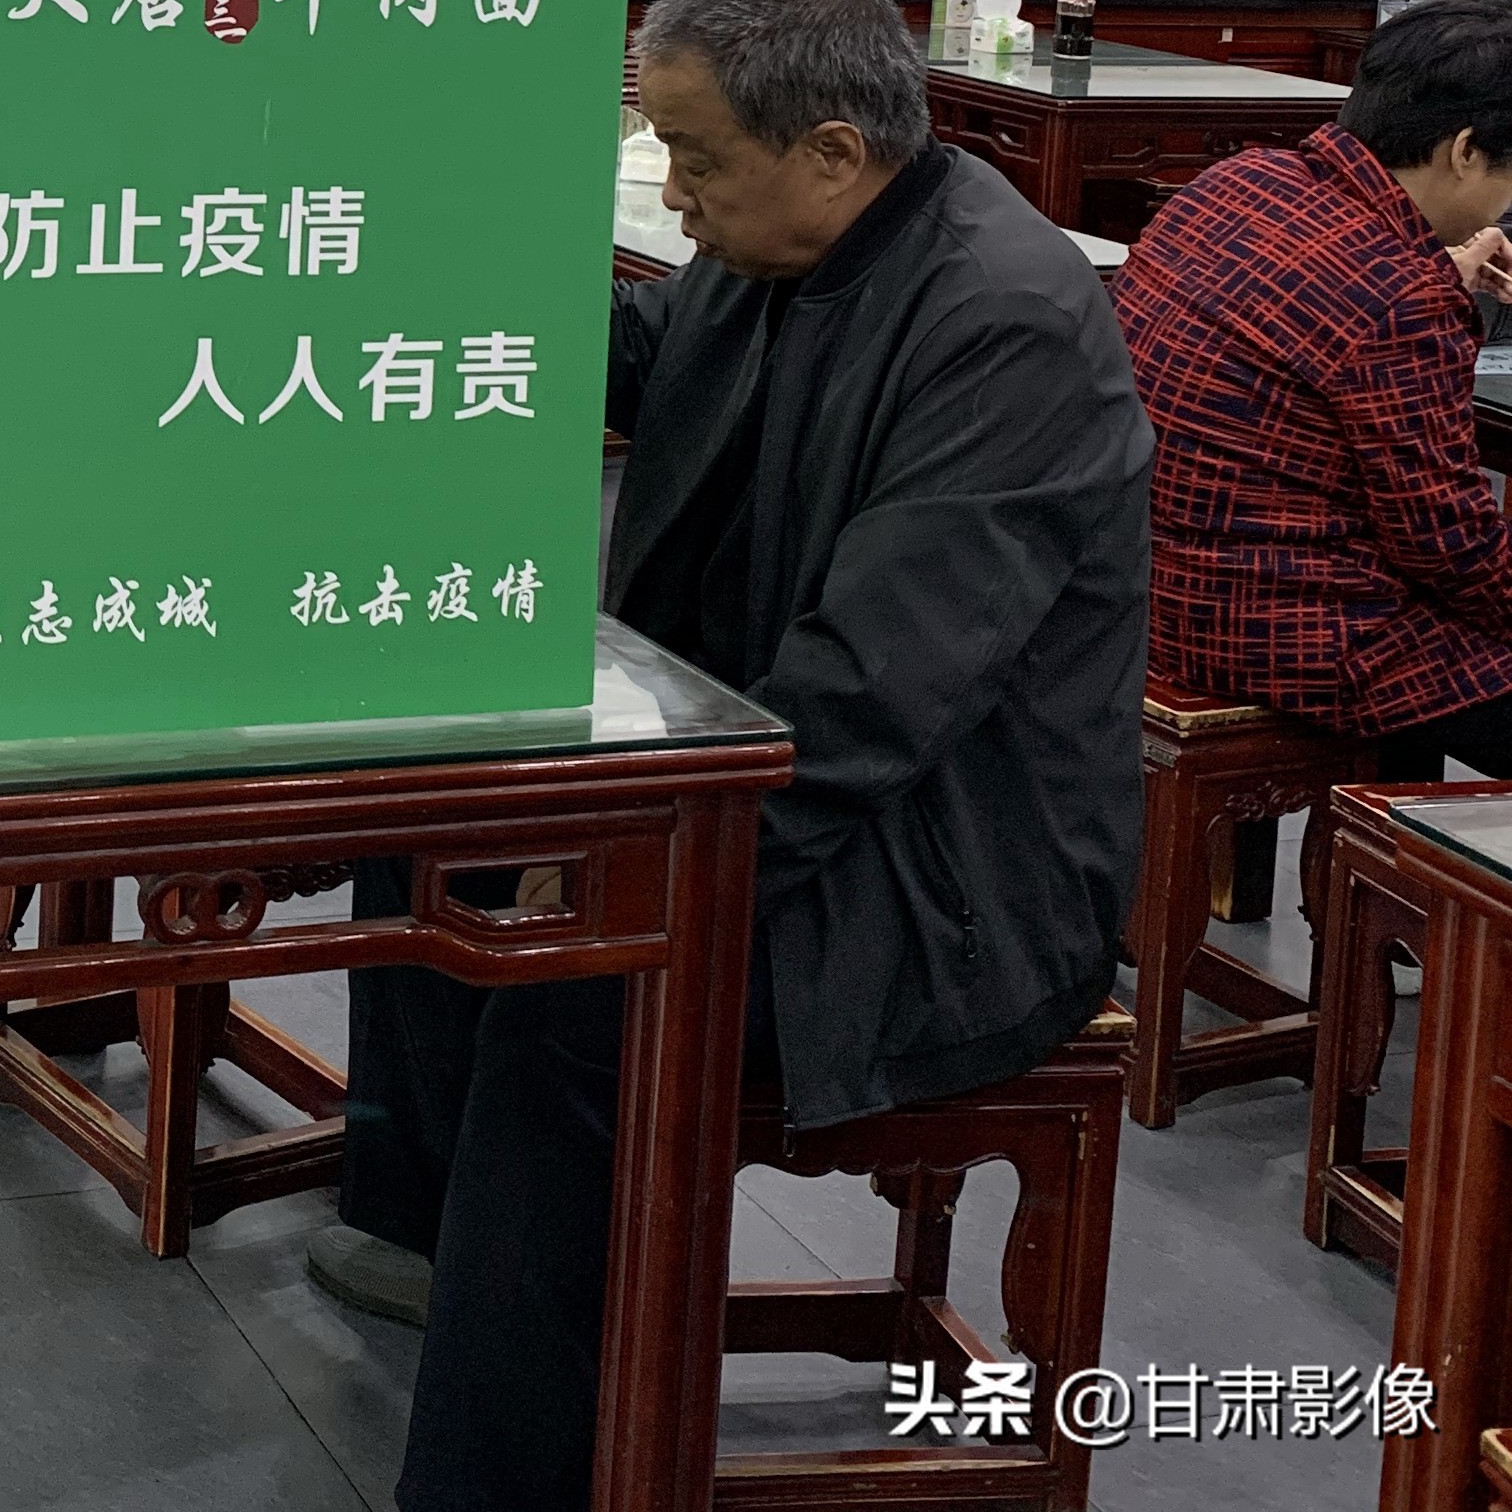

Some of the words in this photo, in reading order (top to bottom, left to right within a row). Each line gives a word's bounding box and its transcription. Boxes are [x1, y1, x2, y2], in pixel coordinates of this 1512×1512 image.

[157, 330, 538, 429] 人人有责
[290, 558, 545, 628] 抗击疫情
